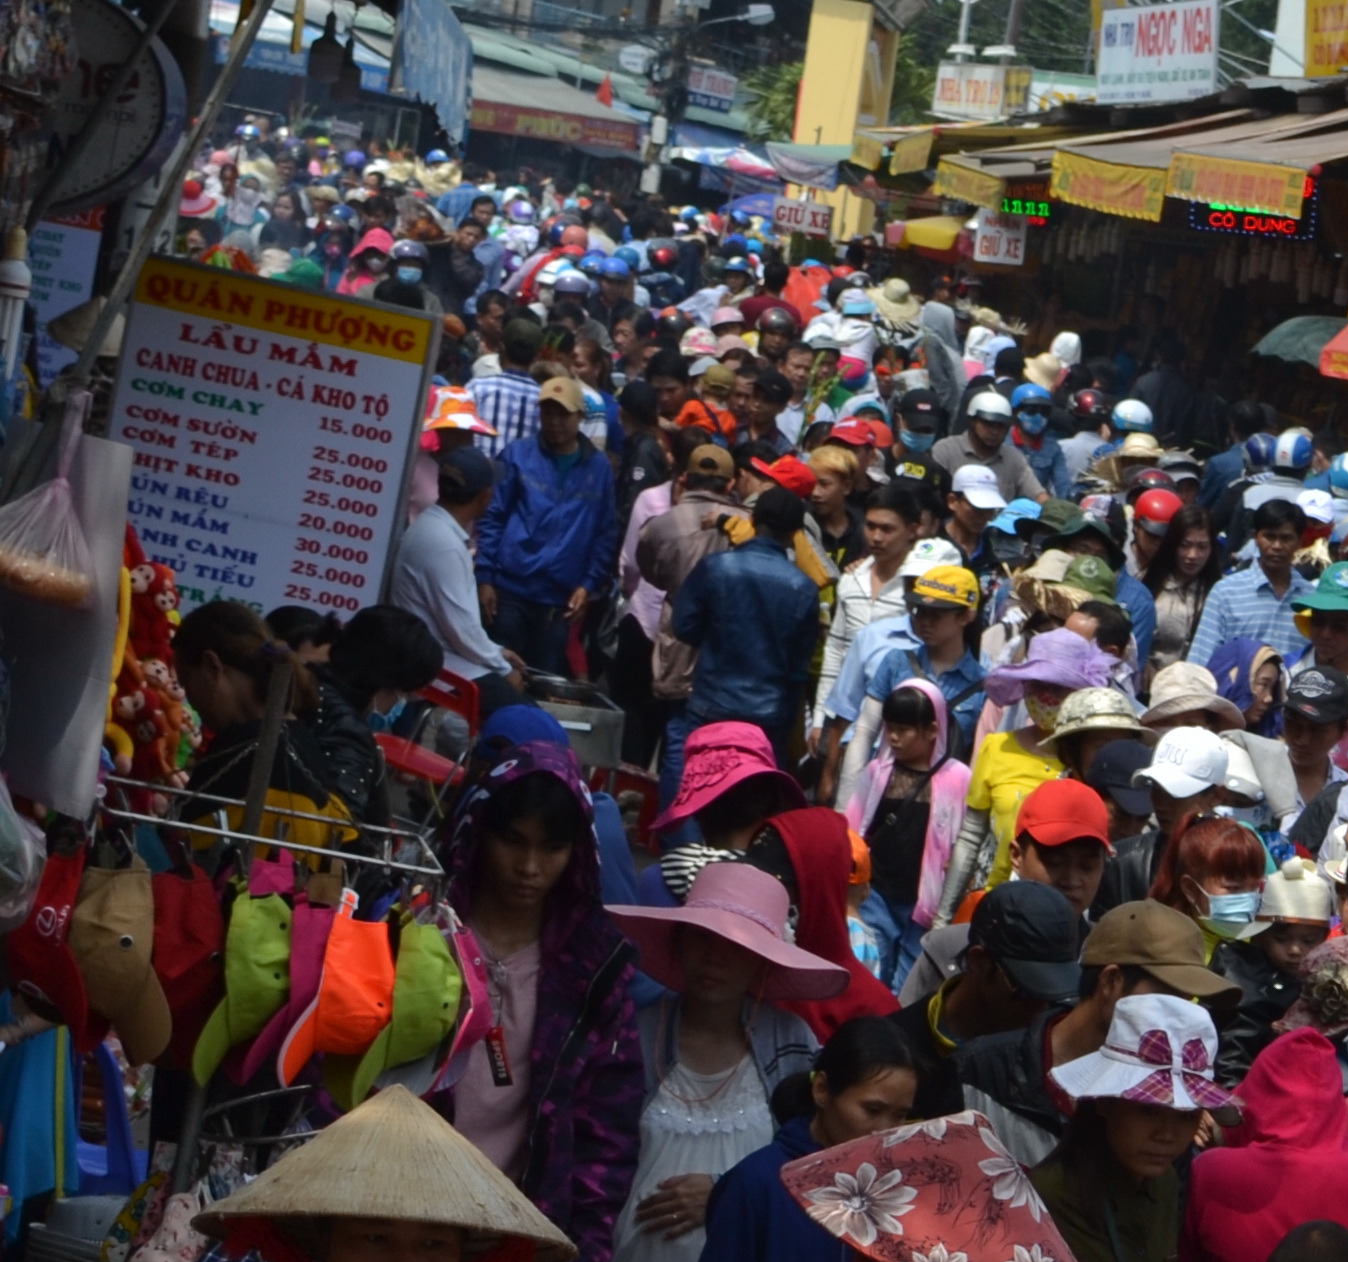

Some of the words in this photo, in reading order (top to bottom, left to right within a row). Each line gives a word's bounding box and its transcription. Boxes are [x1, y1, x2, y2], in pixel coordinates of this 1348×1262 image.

[1181, 6, 1213, 54] NGA
[1208, 210, 1237, 228] CÔ
[1243, 215, 1297, 234] DUNG
[146, 274, 255, 317] QUÁN
[262, 298, 416, 352] PHƯỢNG
[179, 322, 259, 356] LẨU
[268, 341, 359, 377] MẮM
[131, 377, 187, 401] CƠM
[191, 389, 264, 416] CHAY
[319, 416, 393, 444] 15.000
[136, 348, 196, 378] CANH
[202, 362, 260, 391] CHUA
[277, 375, 305, 401] CÁ
[311, 384, 357, 411] KHO
[362, 393, 390, 422] TỘ
[122, 426, 176, 450] CƠM
[189, 438, 240, 462] TÉP
[307, 466, 383, 494] 25.000
[126, 404, 180, 428] CƠM
[186, 415, 258, 444] SƯỜN
[312, 445, 389, 474] 25.000
[130, 471, 171, 498] ÚN
[297, 513, 374, 541] 20.000
[131, 451, 180, 476] HỊT
[184, 463, 241, 487] KHO
[302, 489, 379, 518] 25.000
[127, 495, 165, 520] ÚN
[169, 507, 230, 535] MẮM
[293, 537, 370, 565] 30.000
[185, 538, 259, 566] CANH
[290, 559, 366, 588] 25.000
[193, 562, 256, 588] TIẾU
[283, 584, 360, 613] 25.000
